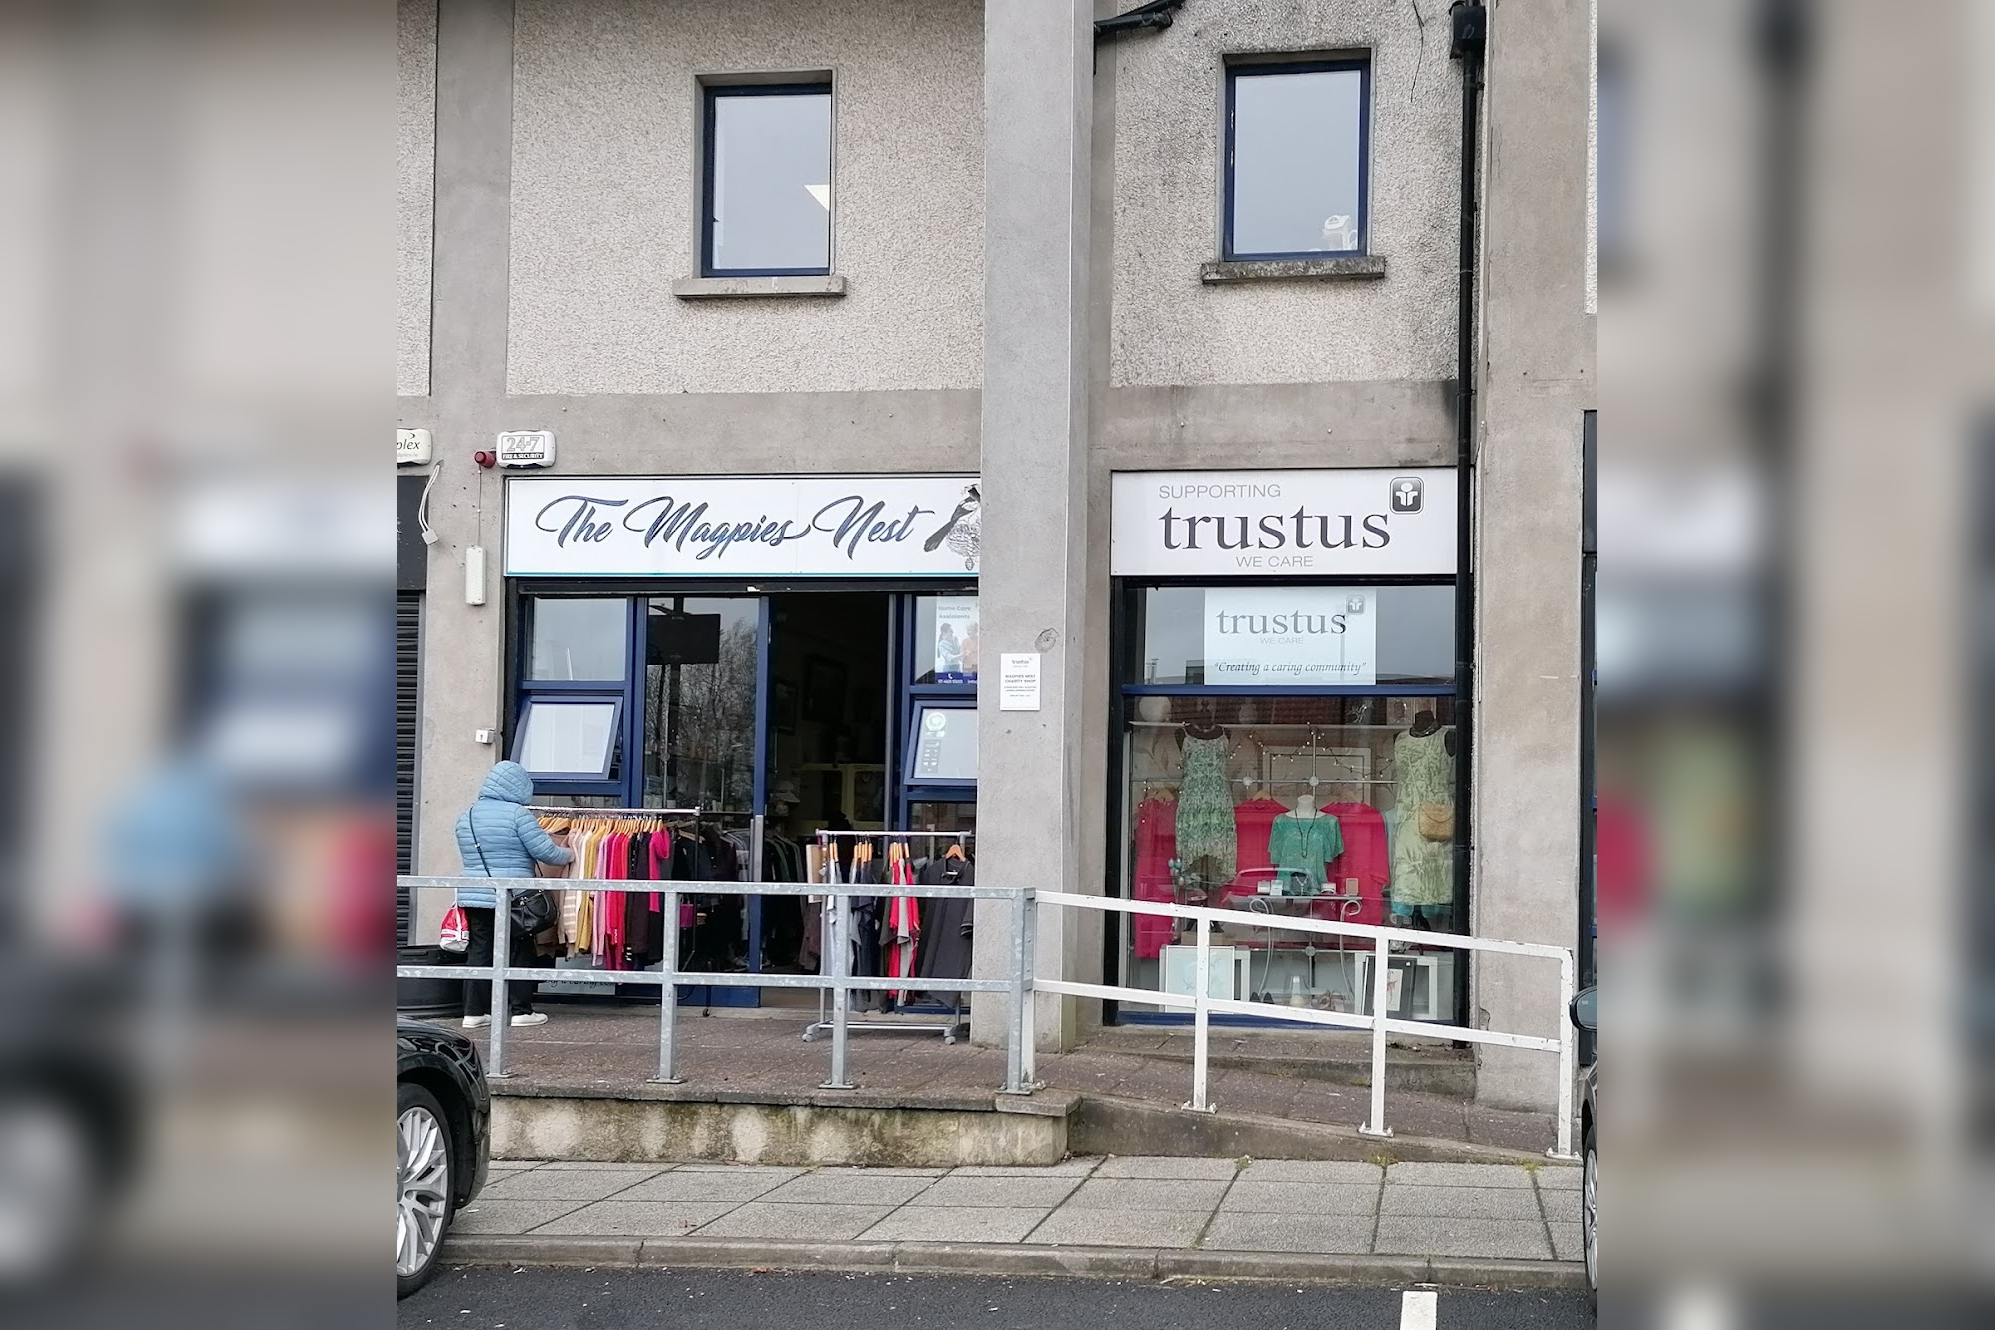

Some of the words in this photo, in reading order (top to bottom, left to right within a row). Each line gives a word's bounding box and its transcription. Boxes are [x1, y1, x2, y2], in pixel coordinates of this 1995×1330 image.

[1158, 484, 1281, 499] SUPPORTING
[535, 495, 629, 549] The
[622, 496, 811, 560] Magpies
[811, 495, 935, 560] Nest
[1158, 505, 1391, 550] trustus
[1235, 556, 1263, 568] WE
[1267, 555, 1314, 567] CARE
[1216, 609, 1347, 635] trustus
[1260, 637, 1276, 645] WE
[1277, 637, 1305, 645] CARE
[1263, 664, 1270, 672] a
[1271, 662, 1303, 676] caring
